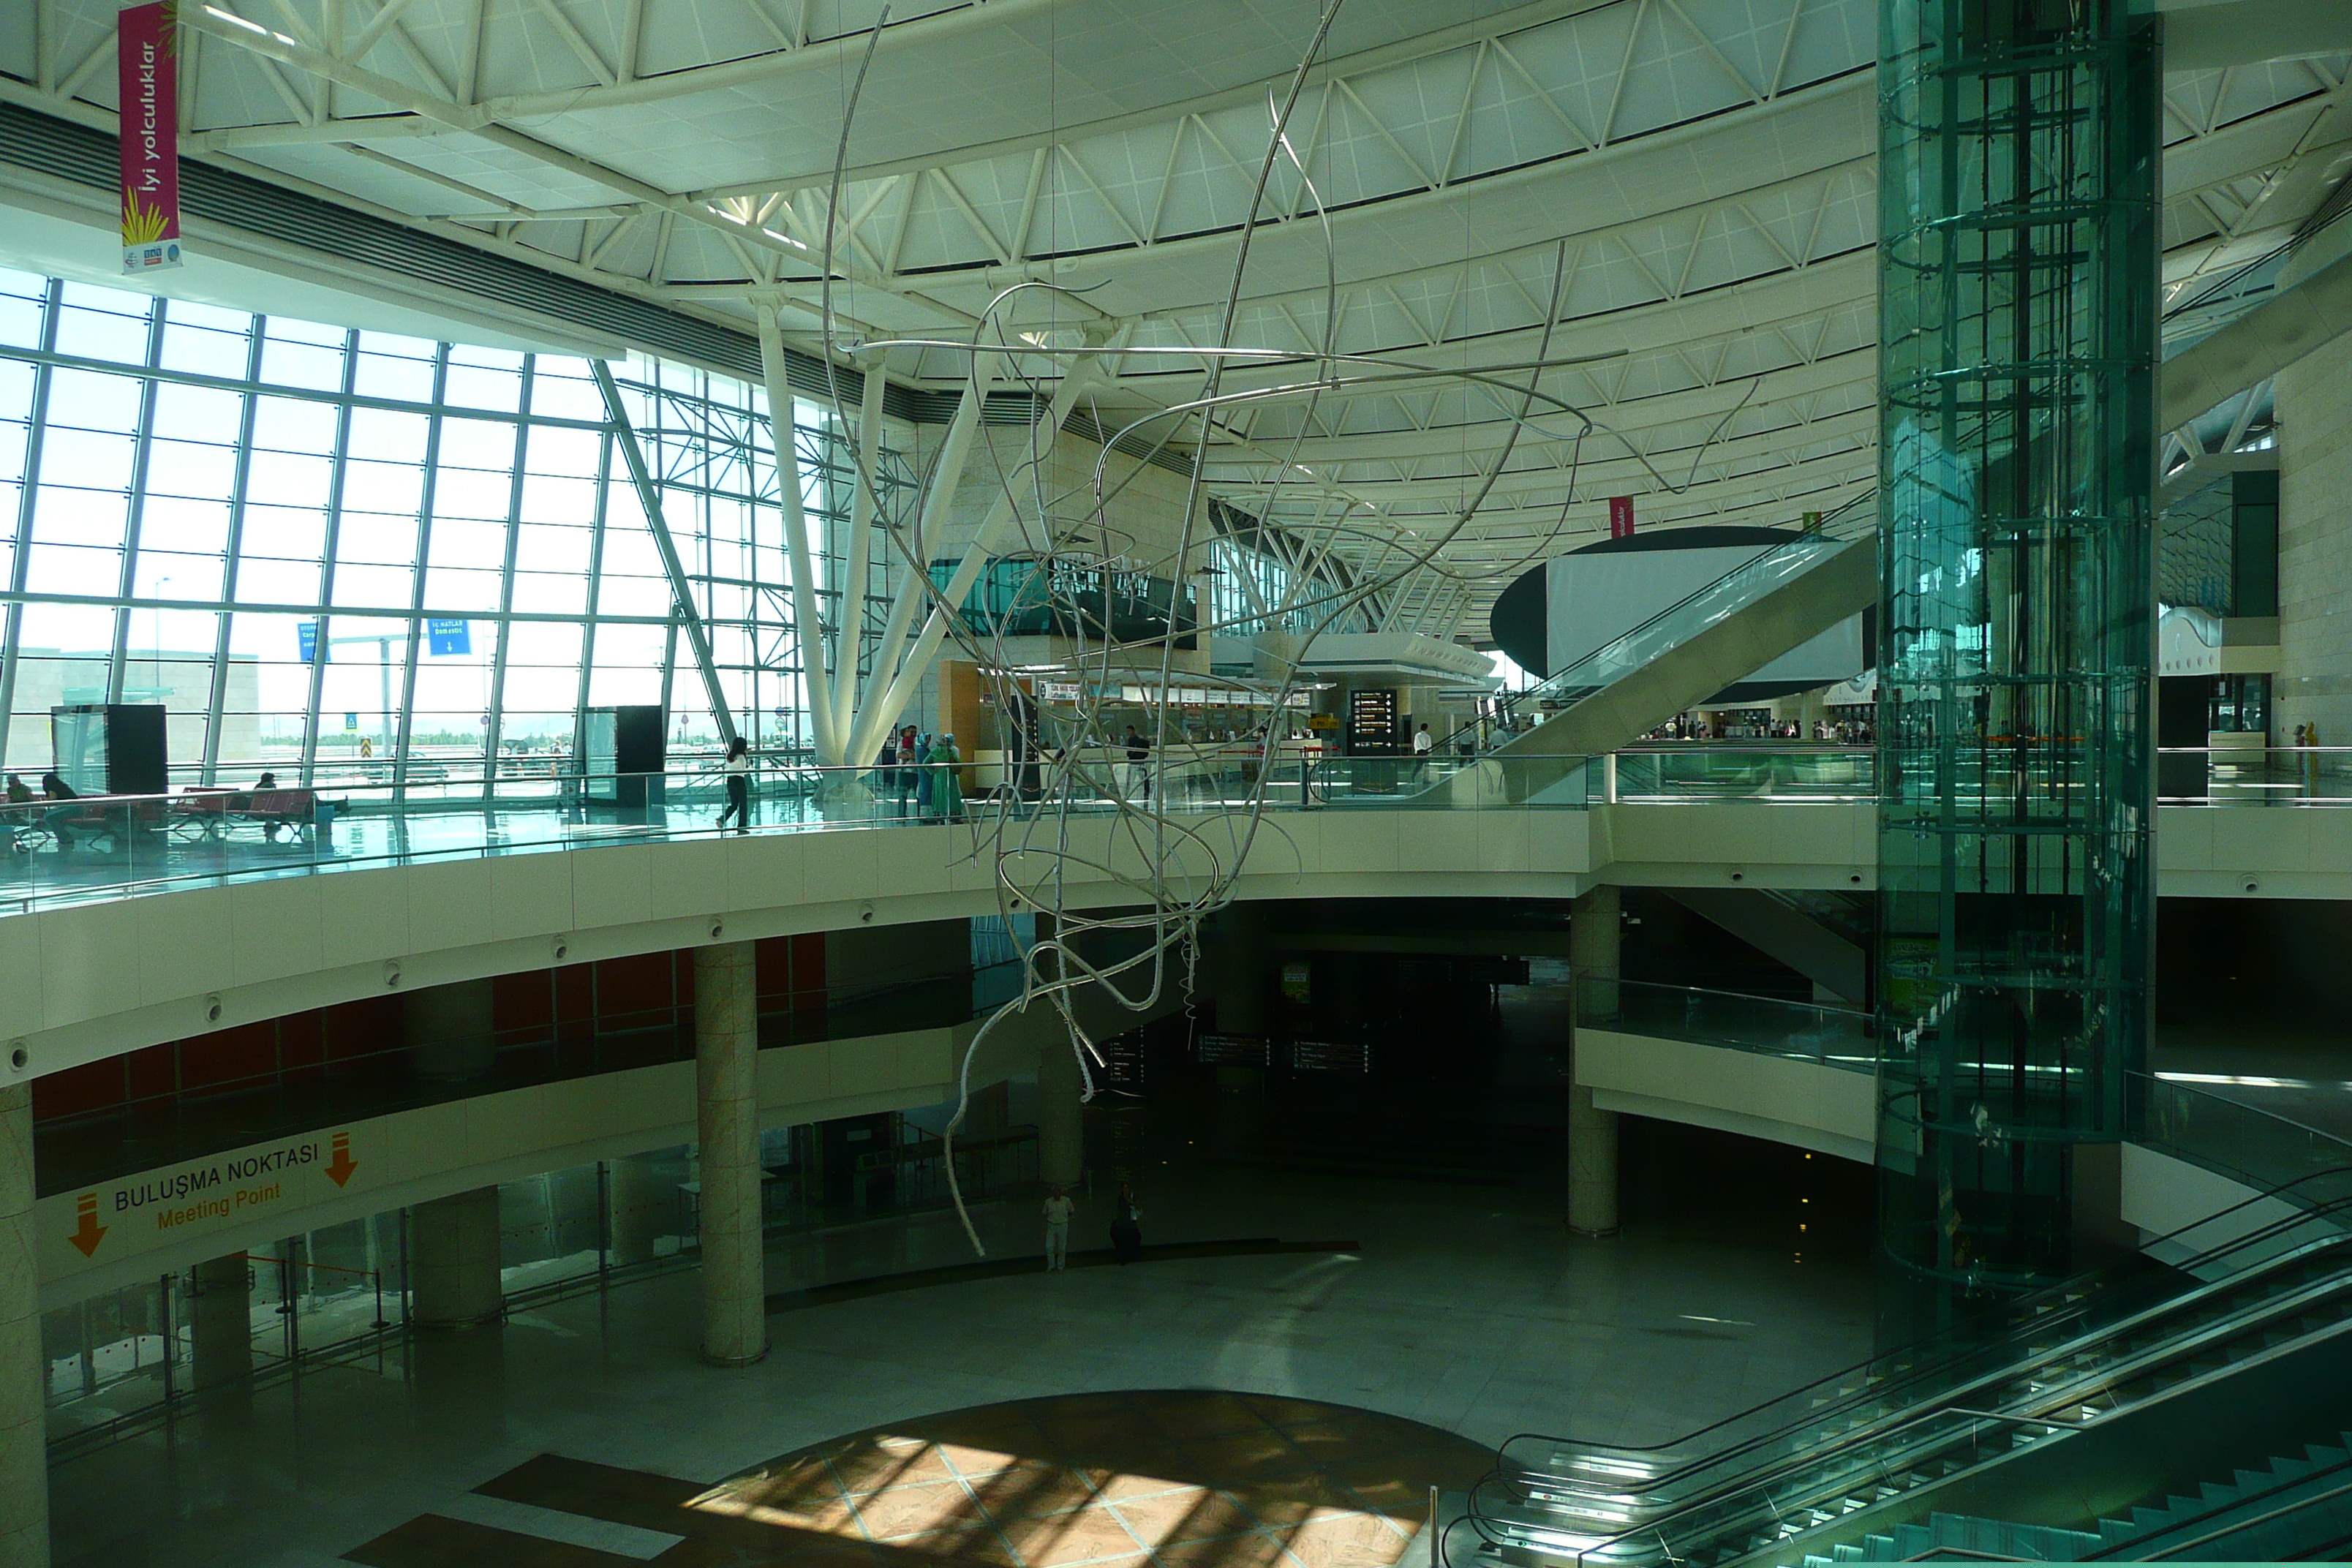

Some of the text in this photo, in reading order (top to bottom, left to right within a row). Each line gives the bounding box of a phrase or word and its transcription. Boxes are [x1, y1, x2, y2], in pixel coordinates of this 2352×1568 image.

[140, 42, 161, 160] yolculuklar
[115, 1143, 318, 1212] BULUŞMA NOKTASI
[157, 1183, 281, 1230] Meeting Point
